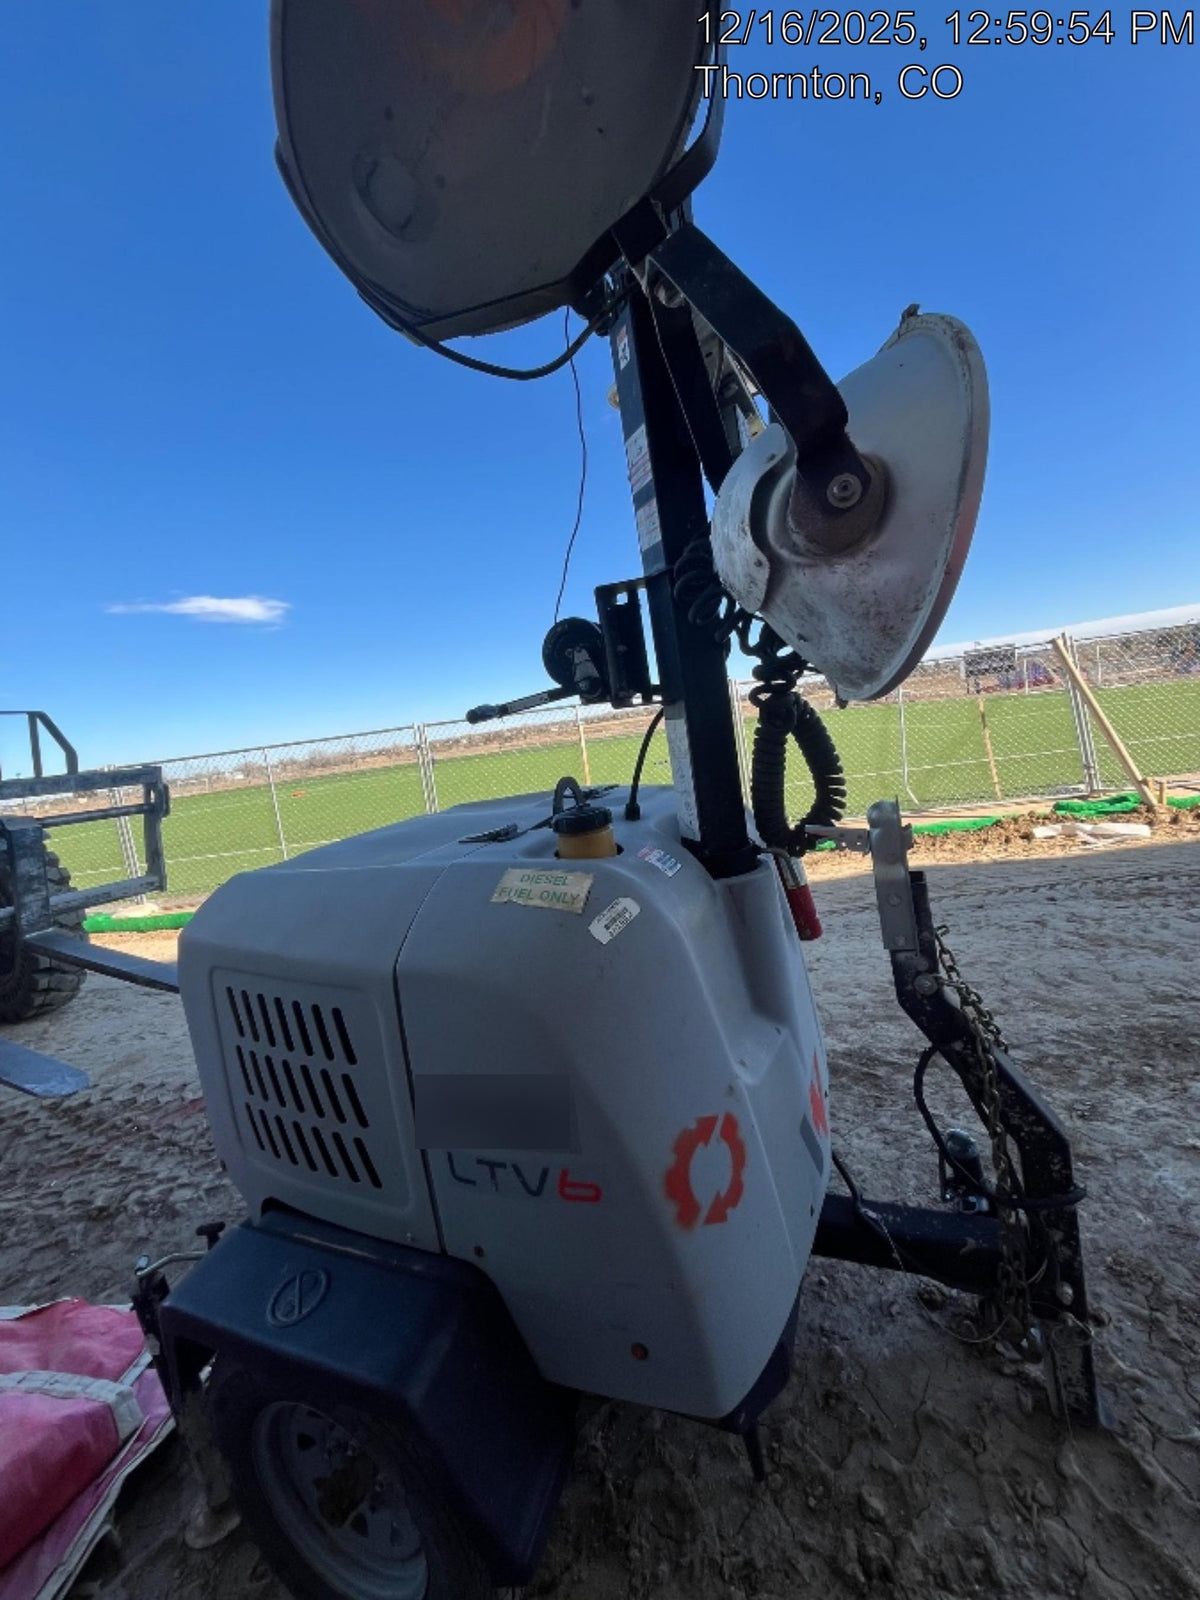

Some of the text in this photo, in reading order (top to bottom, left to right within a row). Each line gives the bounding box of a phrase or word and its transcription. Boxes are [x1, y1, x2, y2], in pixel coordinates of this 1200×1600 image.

[520, 873, 569, 887] DIESEL
[499, 886, 581, 906] FUEL ONLY
[447, 1151, 602, 1204] LTV6
